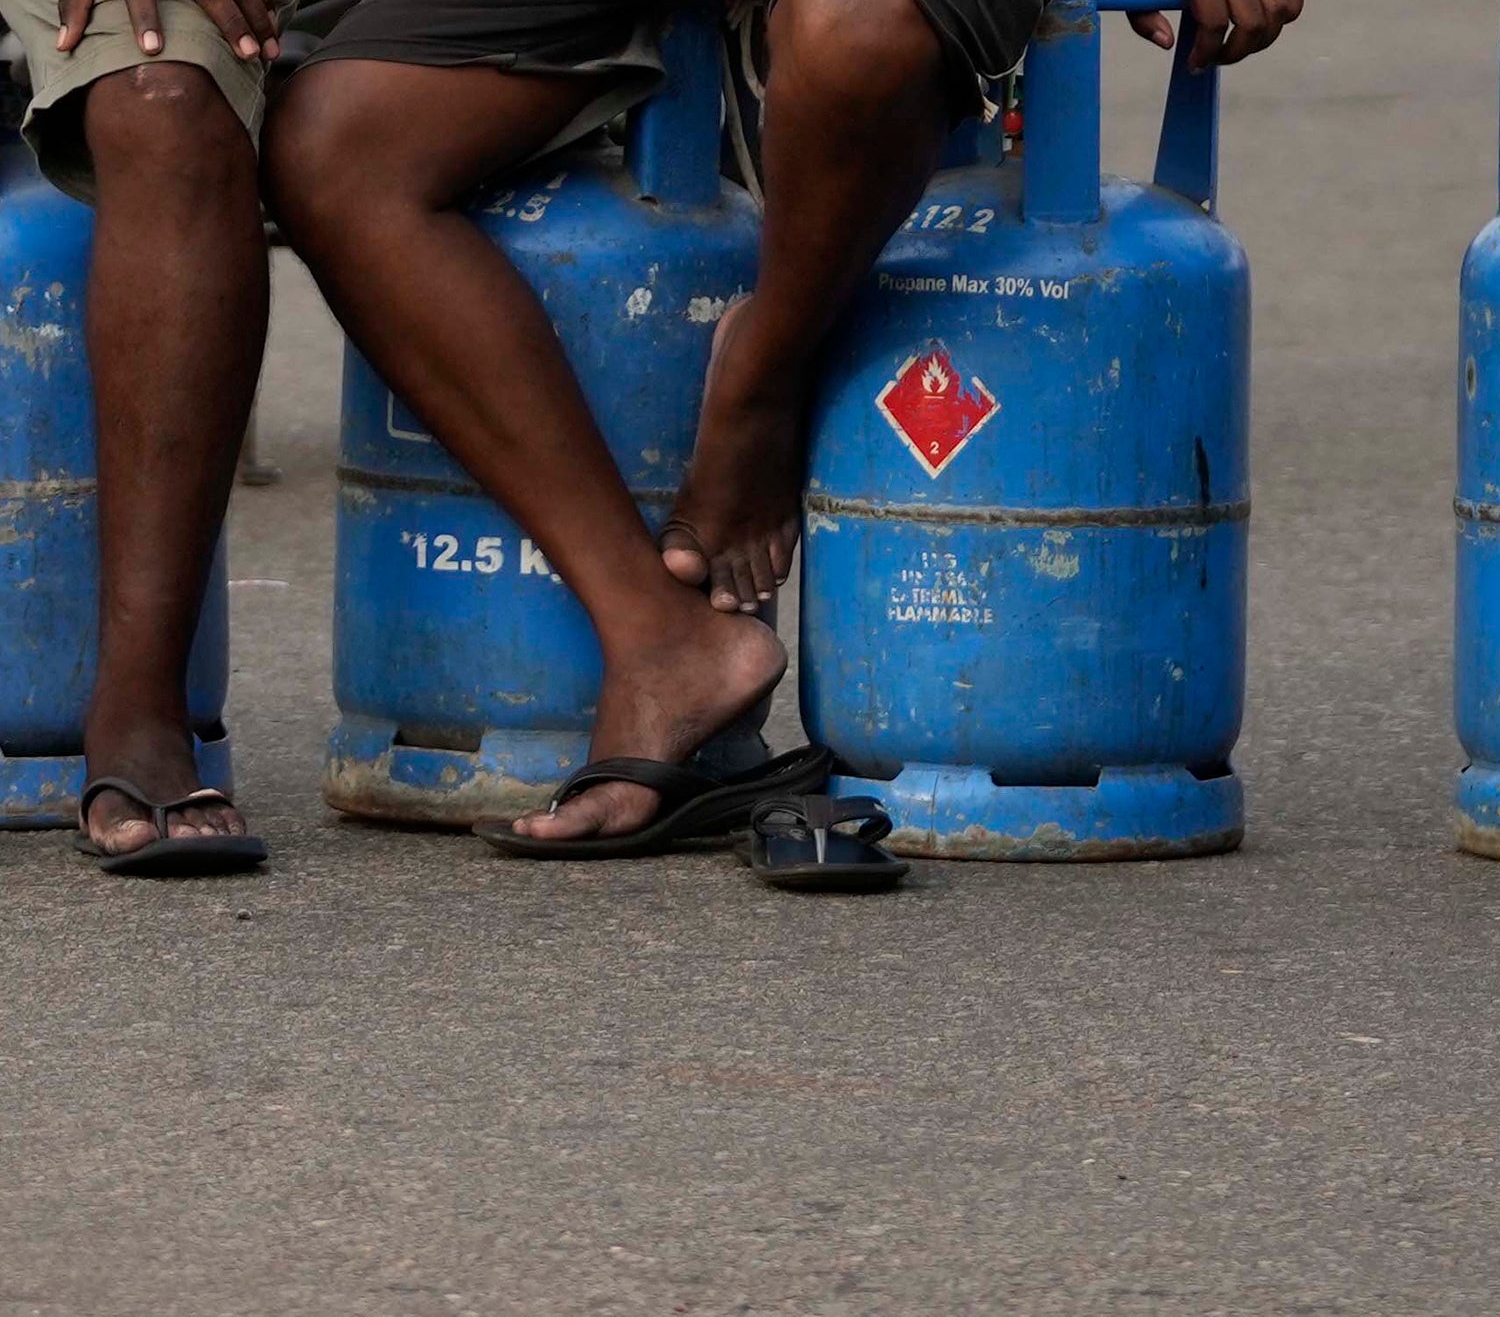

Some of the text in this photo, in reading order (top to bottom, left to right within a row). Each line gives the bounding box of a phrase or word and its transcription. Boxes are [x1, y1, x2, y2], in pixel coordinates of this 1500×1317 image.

[951, 274, 989, 295] Max
[994, 275, 1035, 298] 30%
[1040, 279, 1070, 300] Vol
[929, 441, 940, 455] 2
[410, 532, 563, 585] 12.5 k
